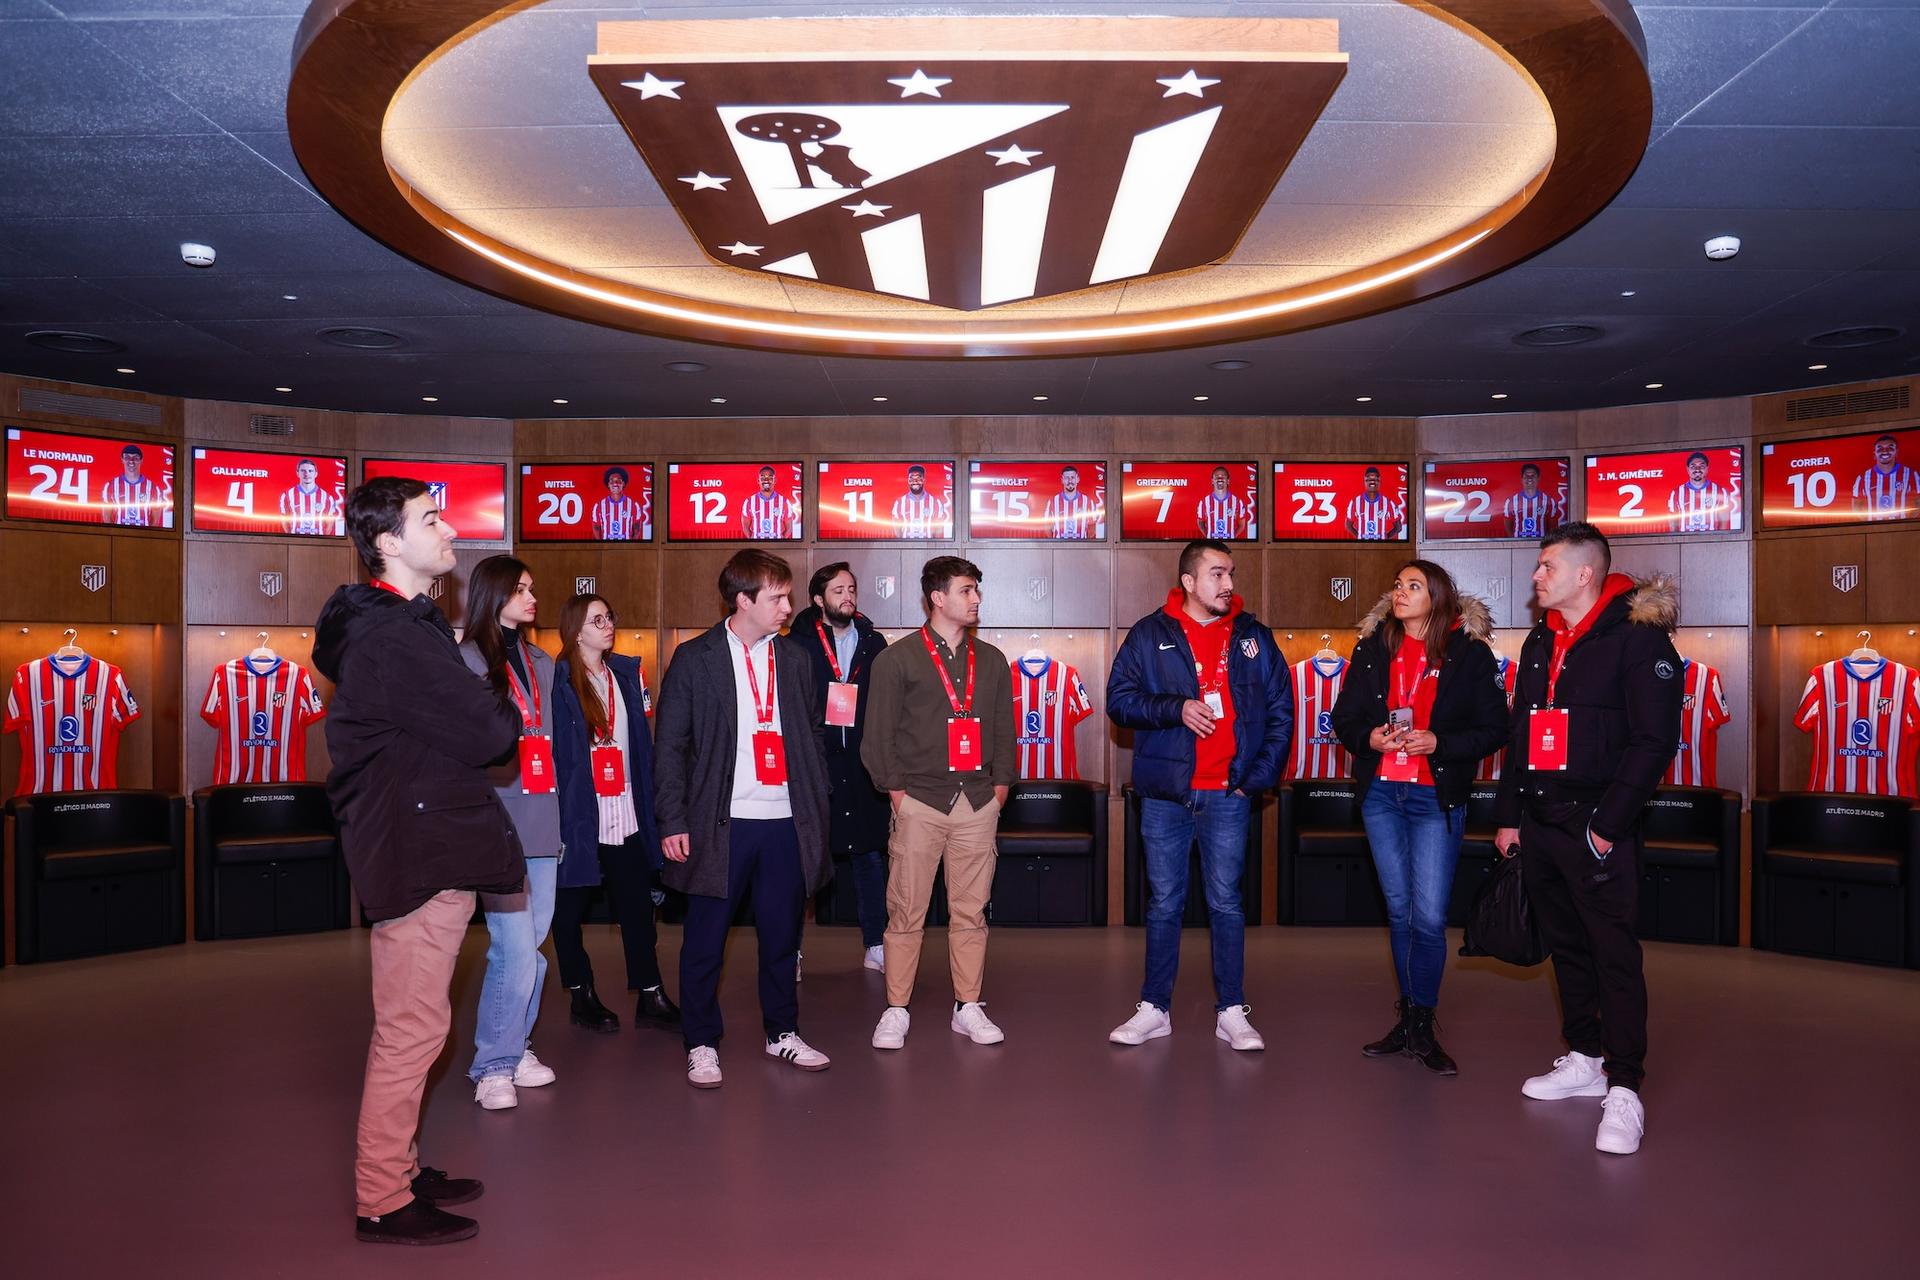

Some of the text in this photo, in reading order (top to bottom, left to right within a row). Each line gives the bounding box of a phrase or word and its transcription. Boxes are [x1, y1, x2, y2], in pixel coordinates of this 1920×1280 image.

[23, 448, 94, 464] LE NORMAND
[1790, 456, 1831, 468] CORREA
[211, 467, 269, 478] GALLAGHER
[1598, 469, 1664, 481] J. M. GIMÉNEZ
[29, 464, 89, 505] 24
[544, 480, 575, 488] WITSEL
[693, 479, 722, 488] S. LINO
[843, 478, 873, 486] LEMAR
[991, 478, 1029, 487] LENGLET
[1136, 478, 1188, 487] GRIEZMANN
[1294, 479, 1333, 487] REINILDO
[1445, 478, 1488, 486] GIULIANO
[1786, 470, 1837, 509] 10
[226, 481, 254, 515] 4
[1618, 484, 1644, 518] 2
[538, 492, 583, 525] 20
[689, 491, 728, 524] 12
[843, 491, 873, 523] 11
[991, 491, 1030, 523] 15
[1151, 491, 1174, 523] 7
[1291, 491, 1337, 524] 23
[1442, 490, 1492, 523] 22
[77, 745, 90, 753] AIR
[267, 739, 278, 747] AIR
[1839, 748, 1884, 758] RIYADH AIR
